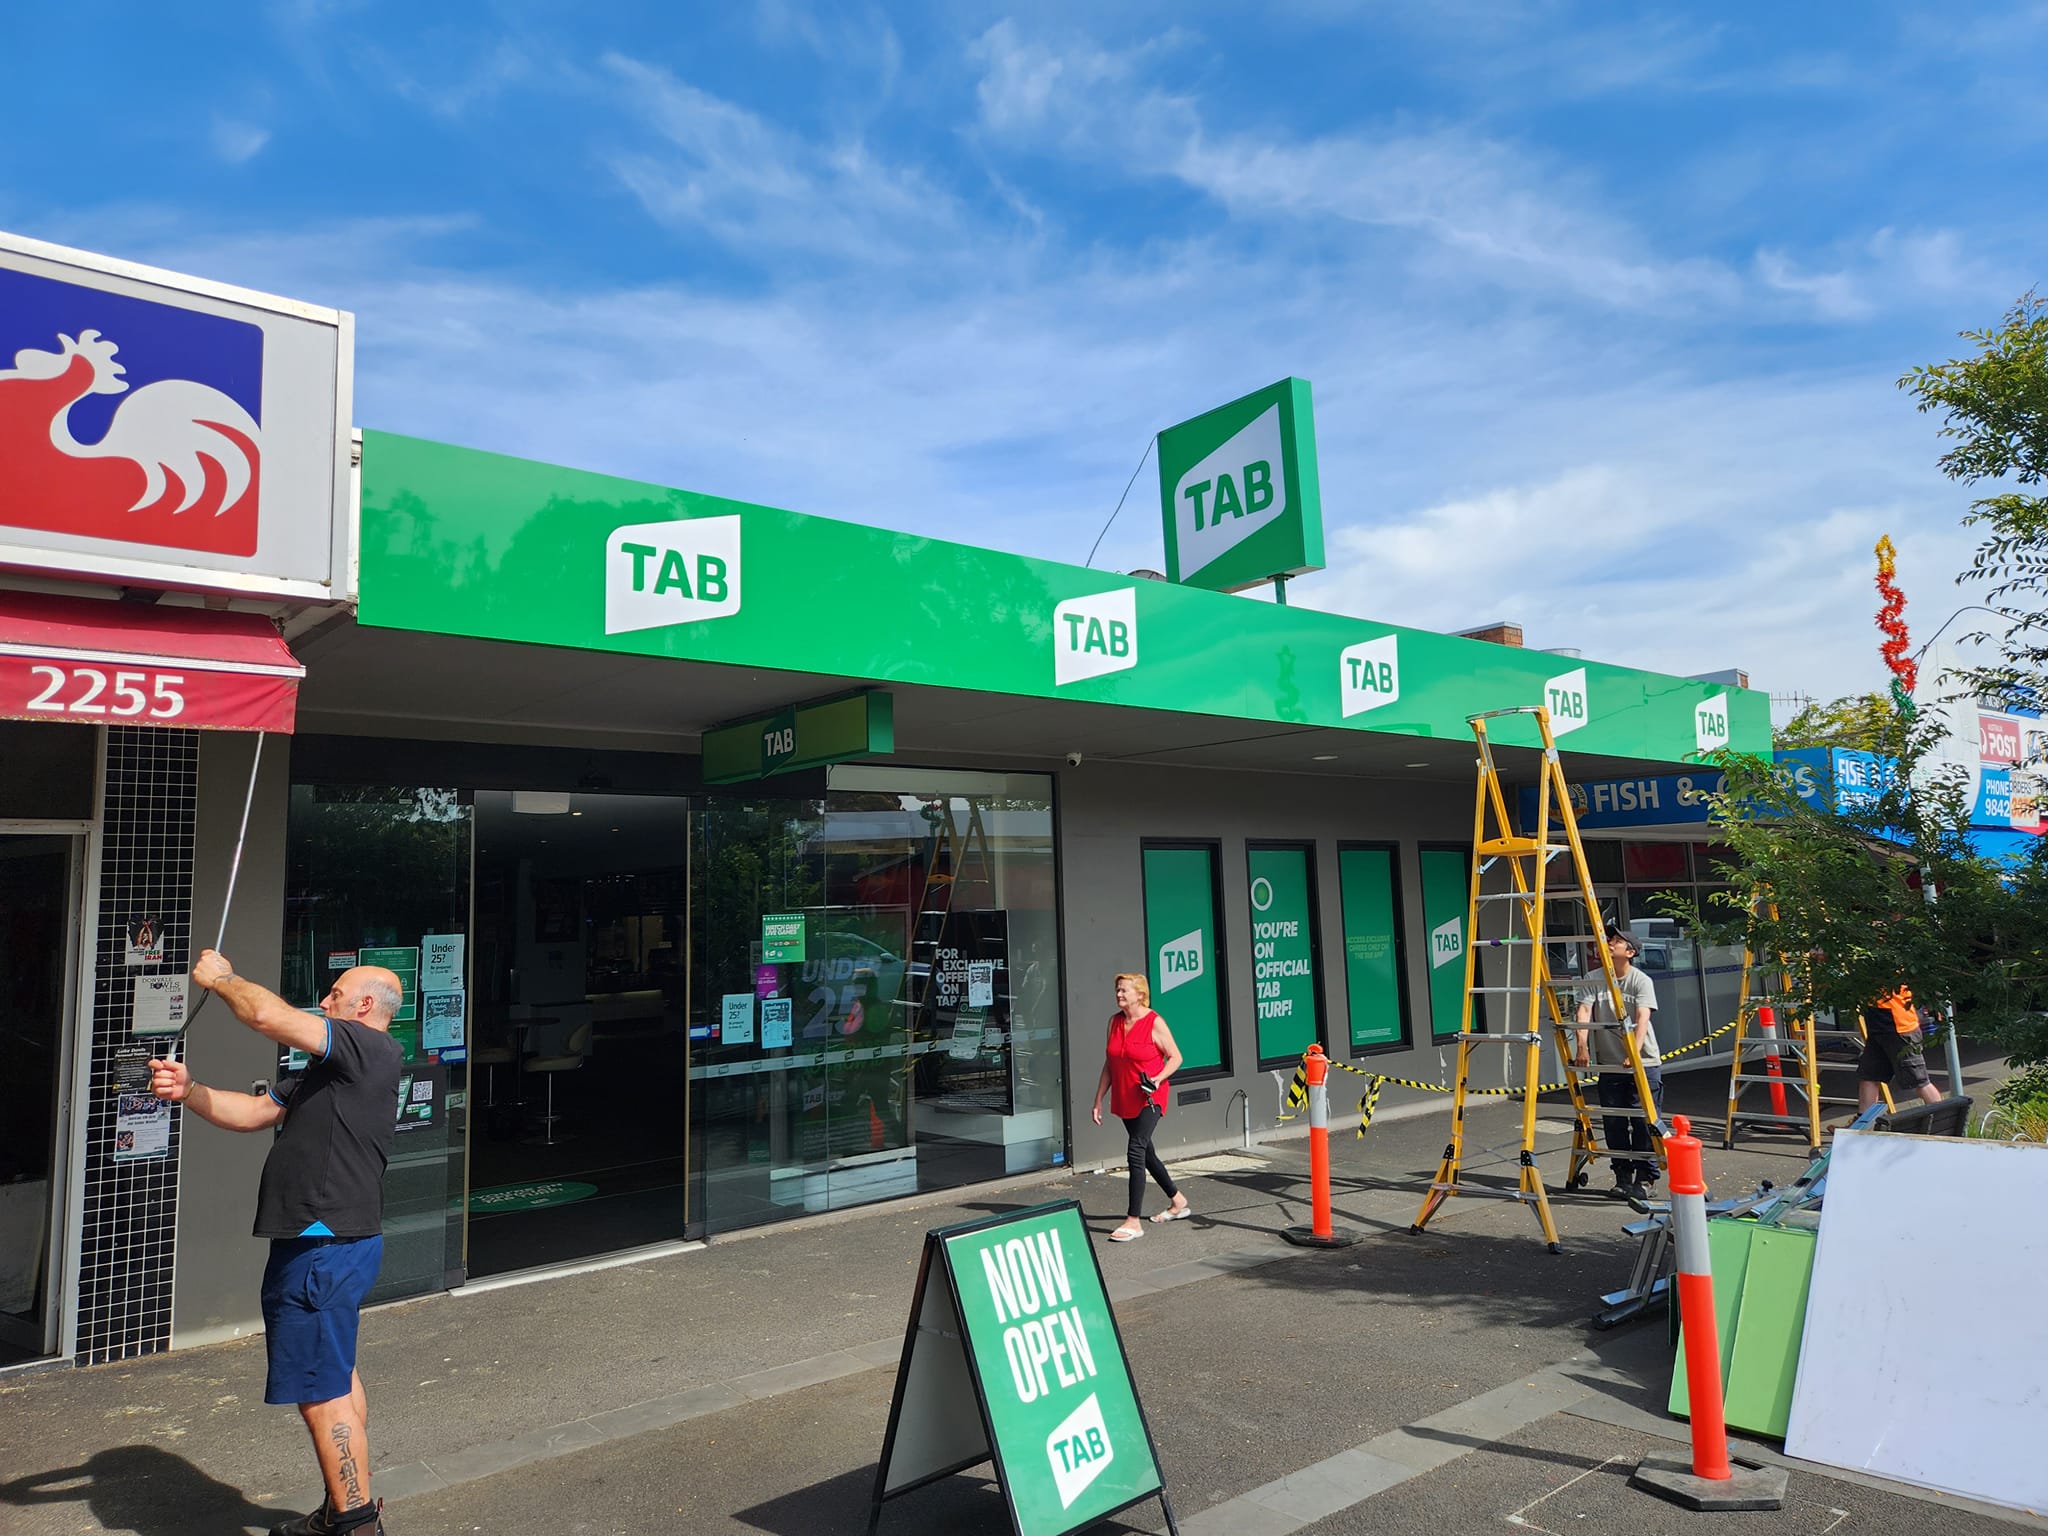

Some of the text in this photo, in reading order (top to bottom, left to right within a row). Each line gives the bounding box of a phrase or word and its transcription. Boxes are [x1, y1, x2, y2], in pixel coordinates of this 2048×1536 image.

[1184, 459, 1275, 533] TAB
[620, 541, 729, 603] TAB
[1062, 612, 1130, 659] TAB
[1346, 656, 1393, 694] TAB
[26, 665, 185, 718] 2255
[1548, 687, 1583, 719] TAB
[1698, 710, 1726, 738] TAB
[764, 728, 794, 757] TAB
[1988, 733, 2017, 757] POST
[1594, 780, 1660, 812] FISH
[1676, 777, 1702, 807] &
[1985, 779, 2009, 796] PHONE
[1985, 797, 2010, 817] 9842
[1253, 921, 1298, 940] YOU'RE
[1435, 933, 1459, 952] TAB
[431, 944, 456, 953] Under
[431, 954, 446, 964] 25?
[935, 948, 958, 960] FOR
[1255, 942, 1274, 959] ON
[1164, 949, 1199, 973] TAB
[1255, 959, 1311, 979] OFFICIAL
[941, 984, 960, 995] ON
[1256, 981, 1281, 999] TAB
[728, 1001, 748, 1010] Under
[1258, 999, 1293, 1019] TURF!
[979, 1229, 1072, 1324] NOW
[1003, 1306, 1097, 1404] OPEN
[1053, 1426, 1106, 1474] TAB
